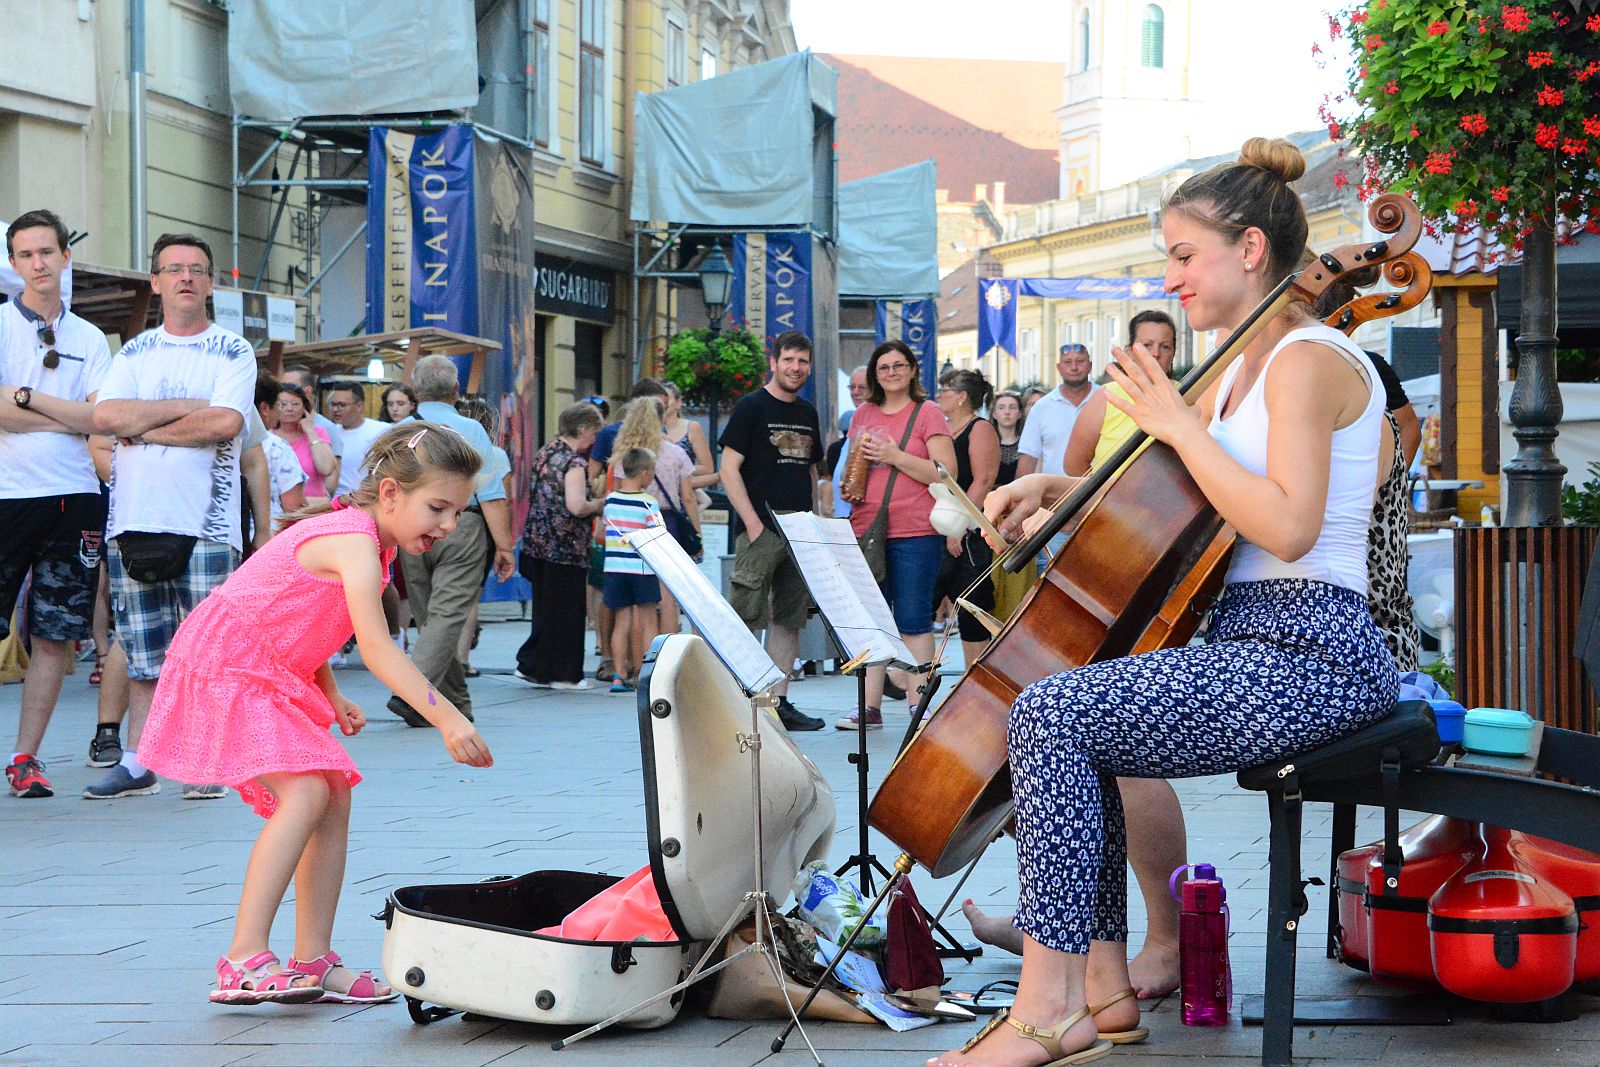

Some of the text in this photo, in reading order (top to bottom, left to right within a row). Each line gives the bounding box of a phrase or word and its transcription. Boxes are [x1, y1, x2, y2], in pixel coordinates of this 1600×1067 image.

[422, 142, 448, 286] NAPOK
[540, 267, 609, 309] SUGARBIRD
[775, 245, 794, 337] APOK
